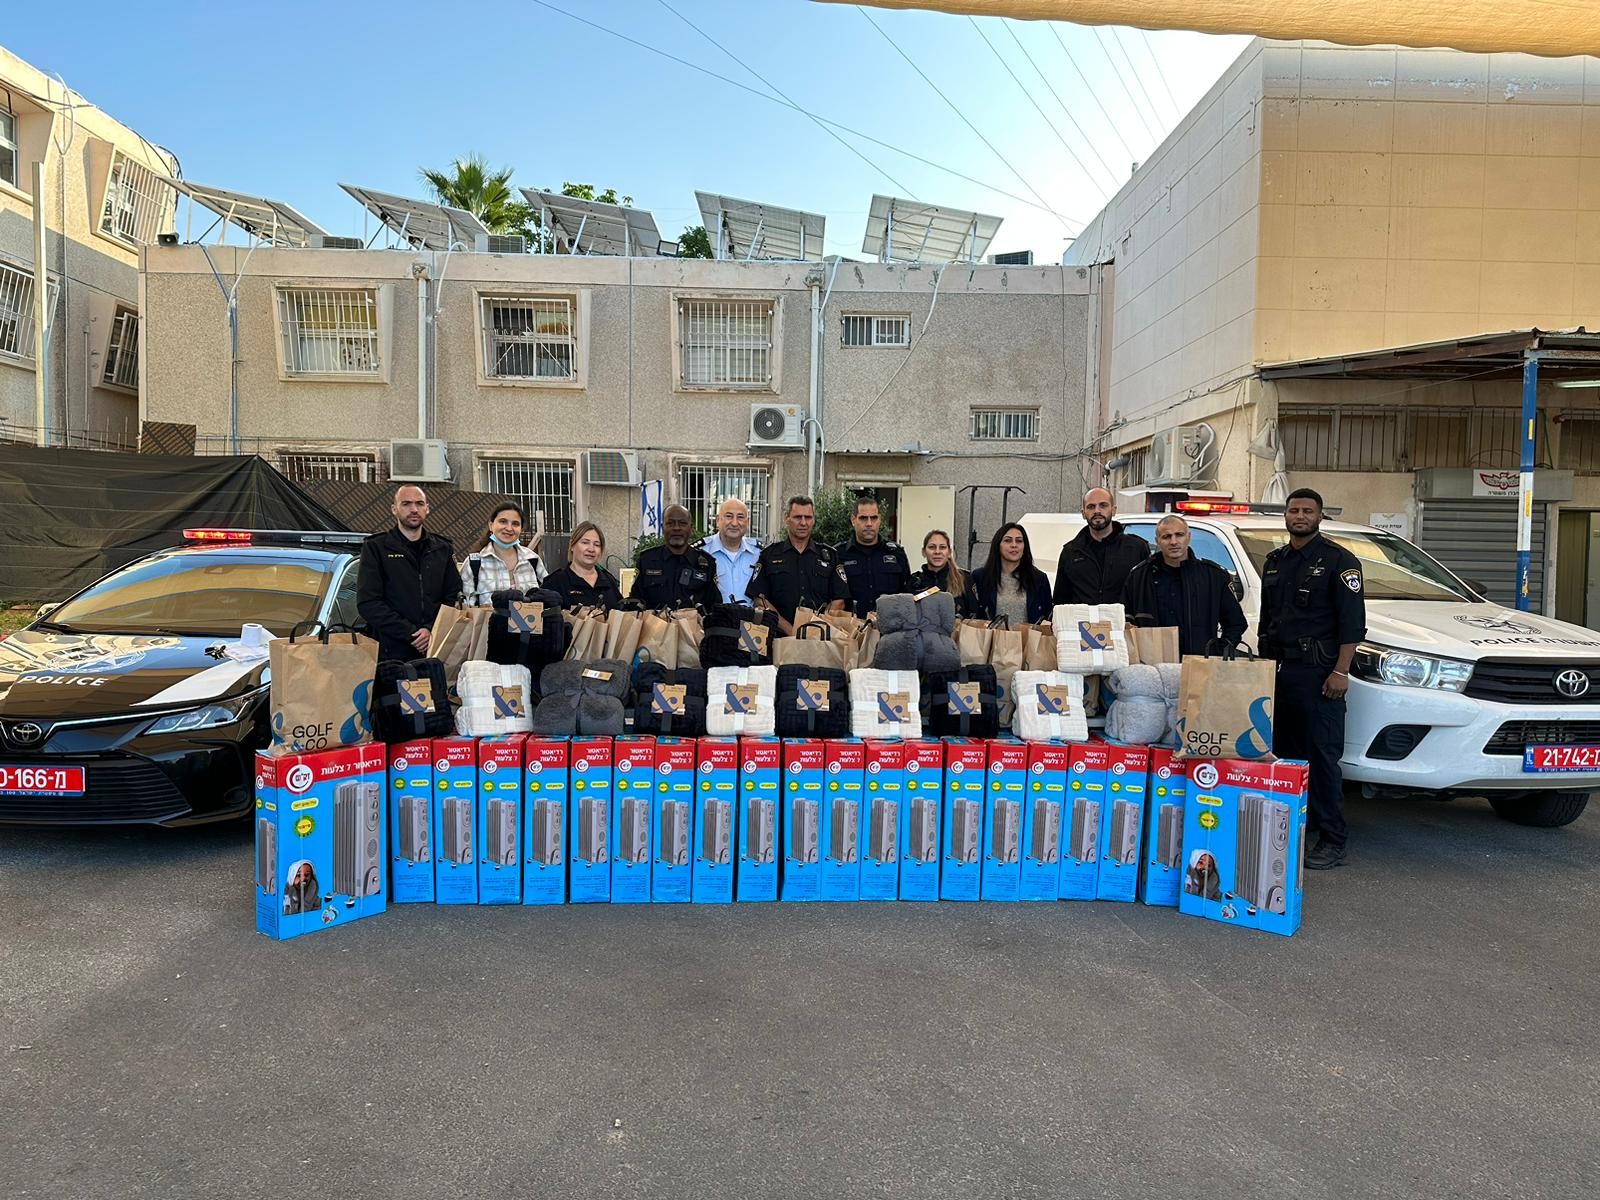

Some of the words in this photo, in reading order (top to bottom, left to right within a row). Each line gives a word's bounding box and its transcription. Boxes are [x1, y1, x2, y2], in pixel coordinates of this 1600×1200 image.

[1470, 638, 1540, 646] POLICE
[18, 676, 108, 686] POLICE
[292, 722, 333, 738] GOLF
[1187, 731, 1228, 744] GOLF
[353, 759, 381, 769] רדיאטור
[321, 765, 344, 775] צלעות
[1226, 772, 1251, 783] צלעות
[1261, 777, 1293, 788] רדיאטור
